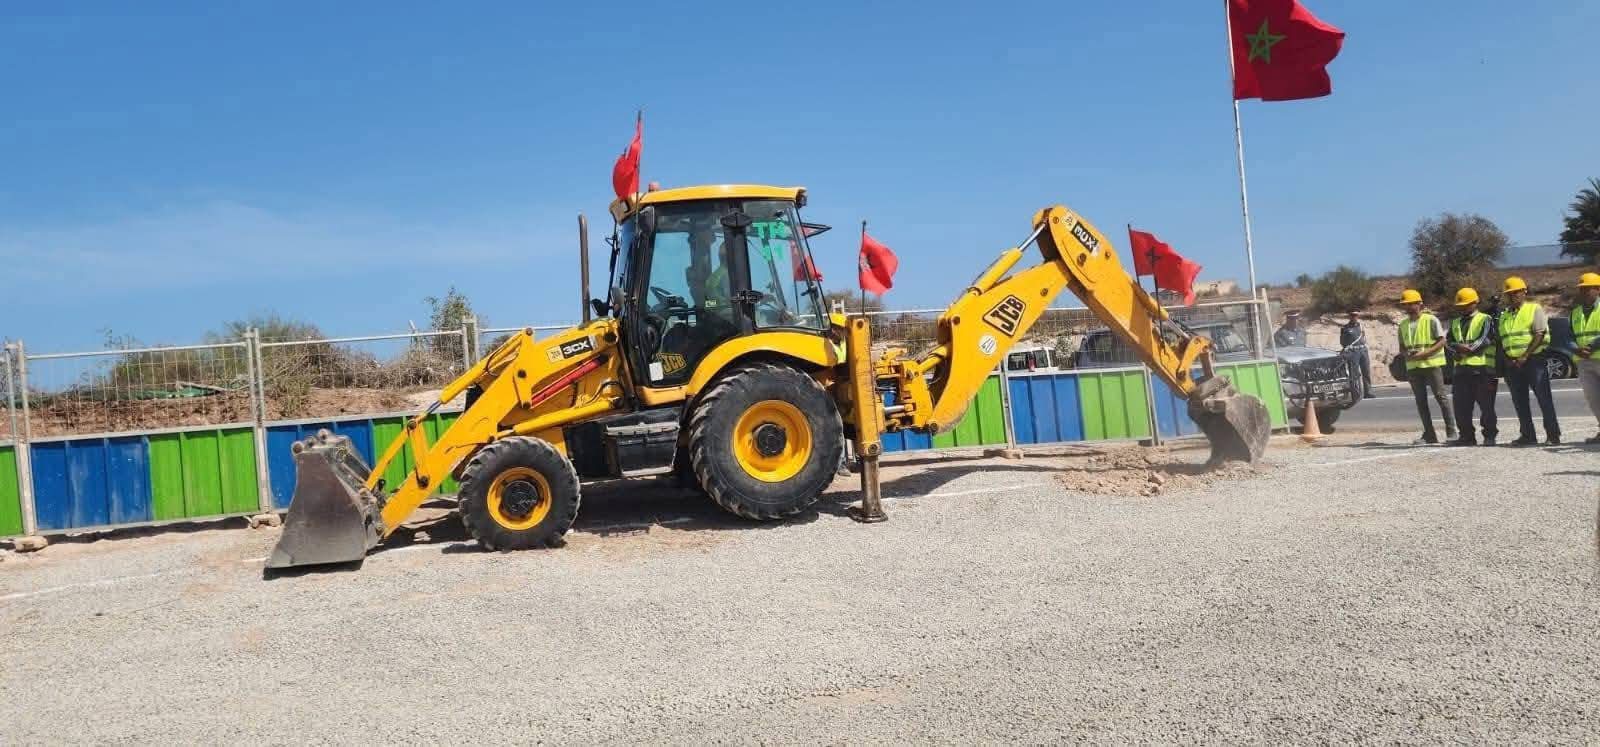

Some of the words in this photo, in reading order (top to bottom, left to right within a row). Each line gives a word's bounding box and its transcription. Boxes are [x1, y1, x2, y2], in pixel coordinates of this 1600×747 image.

[990, 297, 1024, 332] JCB
[562, 340, 590, 355] 3CX
[663, 354, 686, 373] JCB
